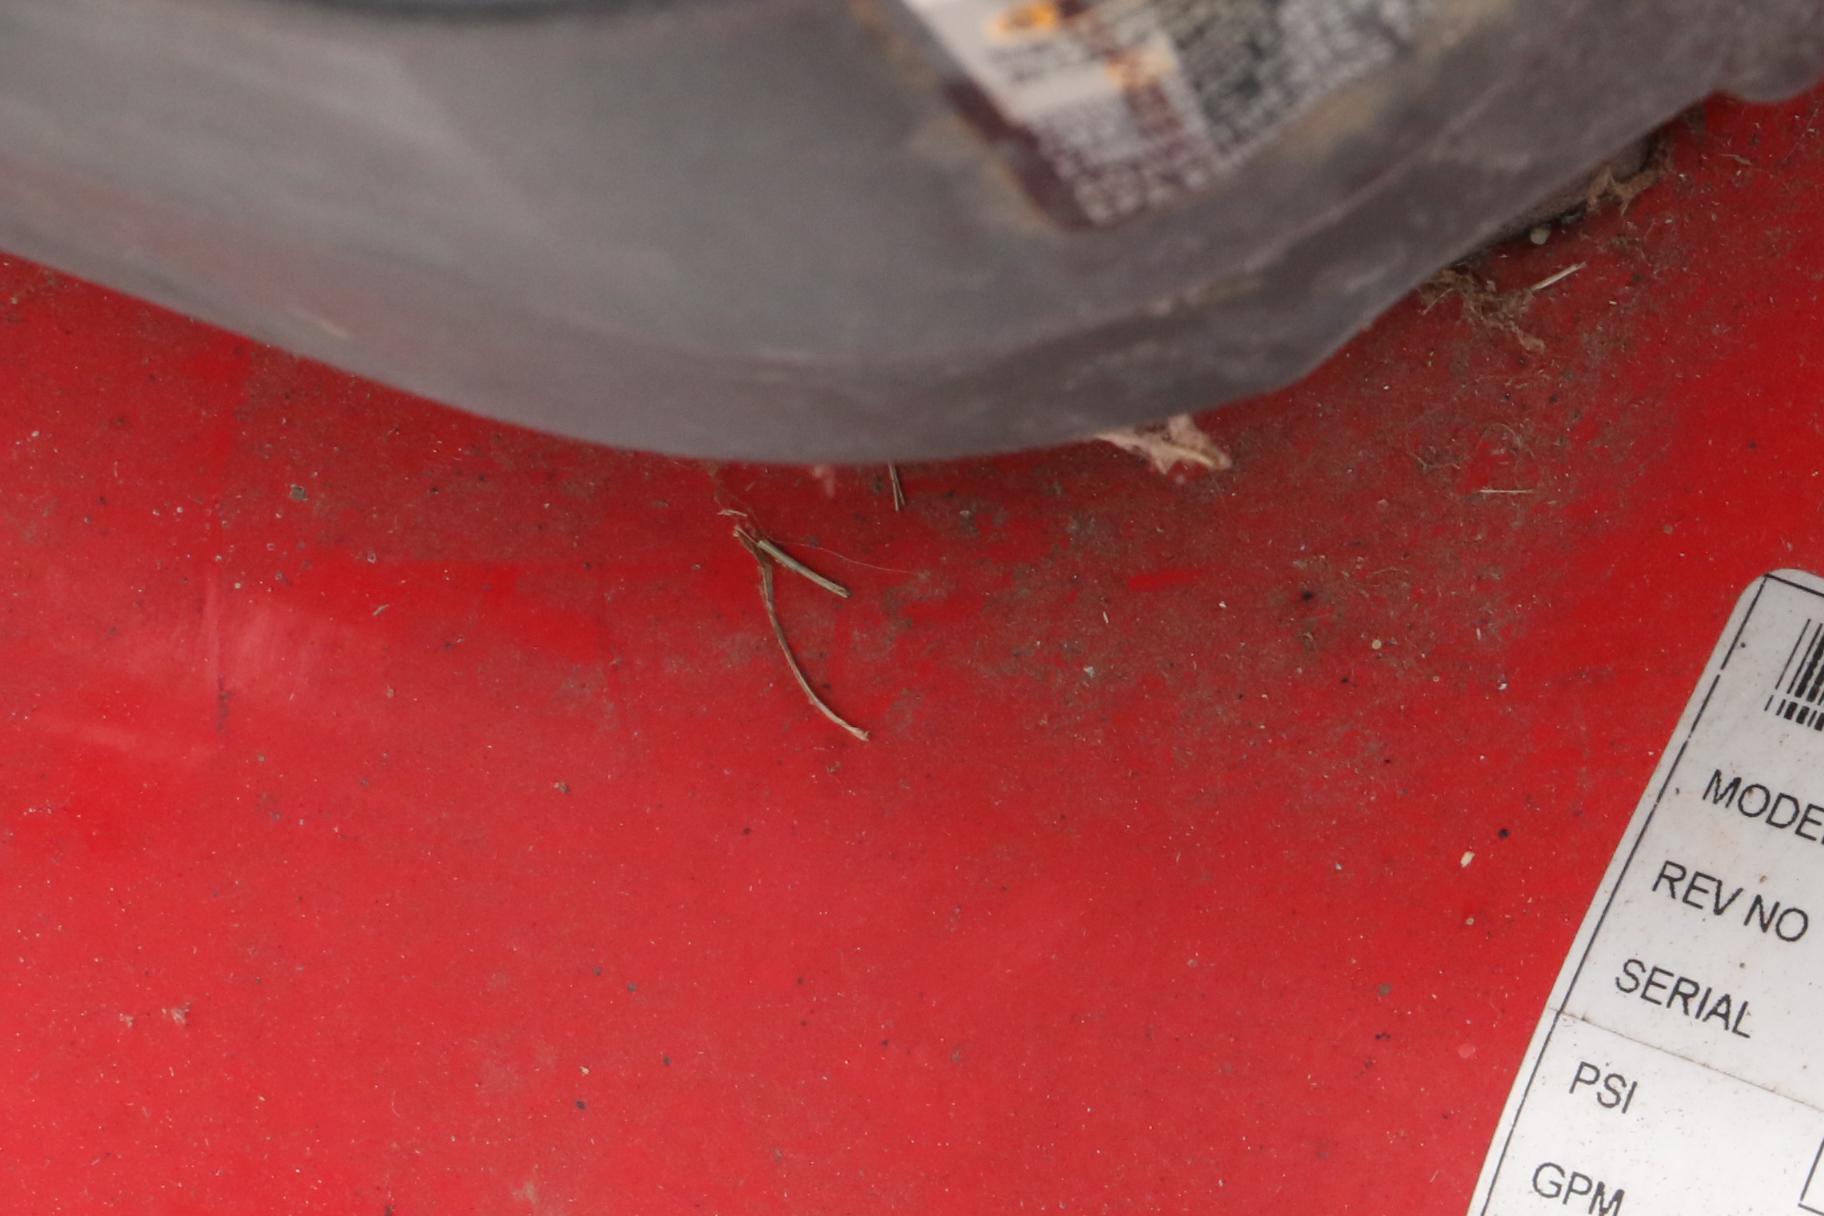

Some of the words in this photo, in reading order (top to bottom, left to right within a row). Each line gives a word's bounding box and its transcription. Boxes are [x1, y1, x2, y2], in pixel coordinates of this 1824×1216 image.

[1652, 860, 1743, 915] REV
[1744, 895, 1808, 942] NO
[1616, 959, 1750, 1038] SERIAL
[1570, 1062, 1637, 1113] PSI
